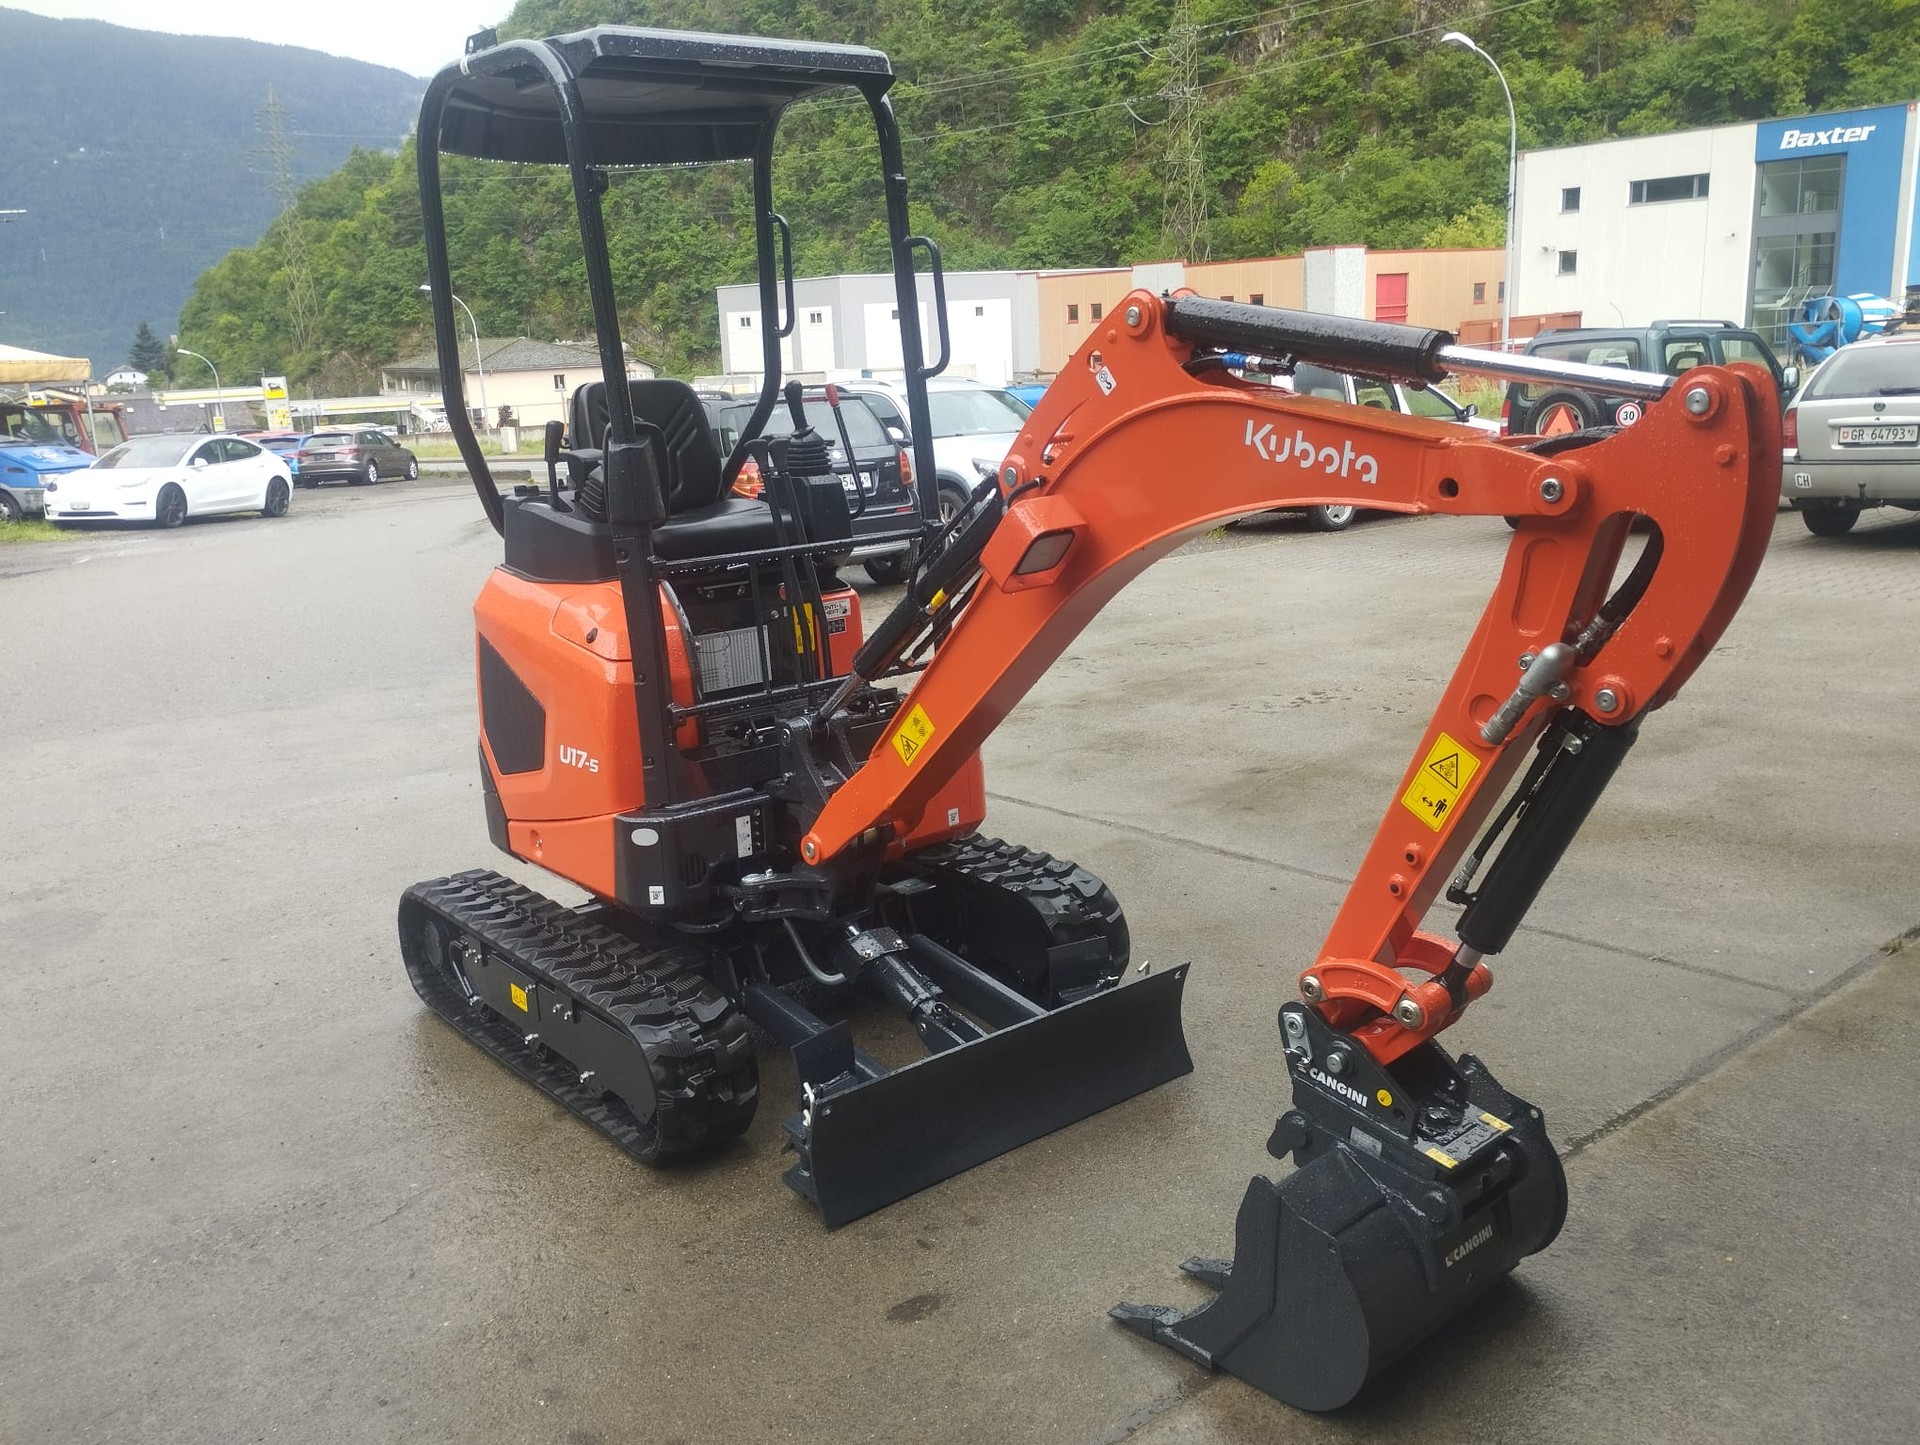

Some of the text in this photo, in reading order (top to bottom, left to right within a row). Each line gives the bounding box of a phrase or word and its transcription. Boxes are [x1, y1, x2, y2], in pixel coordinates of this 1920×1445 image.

[1780, 125, 1876, 149] Baxter
[1623, 411, 1635, 421] 30
[1851, 428, 1906, 440] GR 64793
[1245, 419, 1378, 485] Kubota
[1796, 475, 1810, 487] CH
[560, 744, 599, 773] U17-5
[1309, 1067, 1368, 1108] CANGINI
[1453, 1223, 1493, 1262] CANGINI
